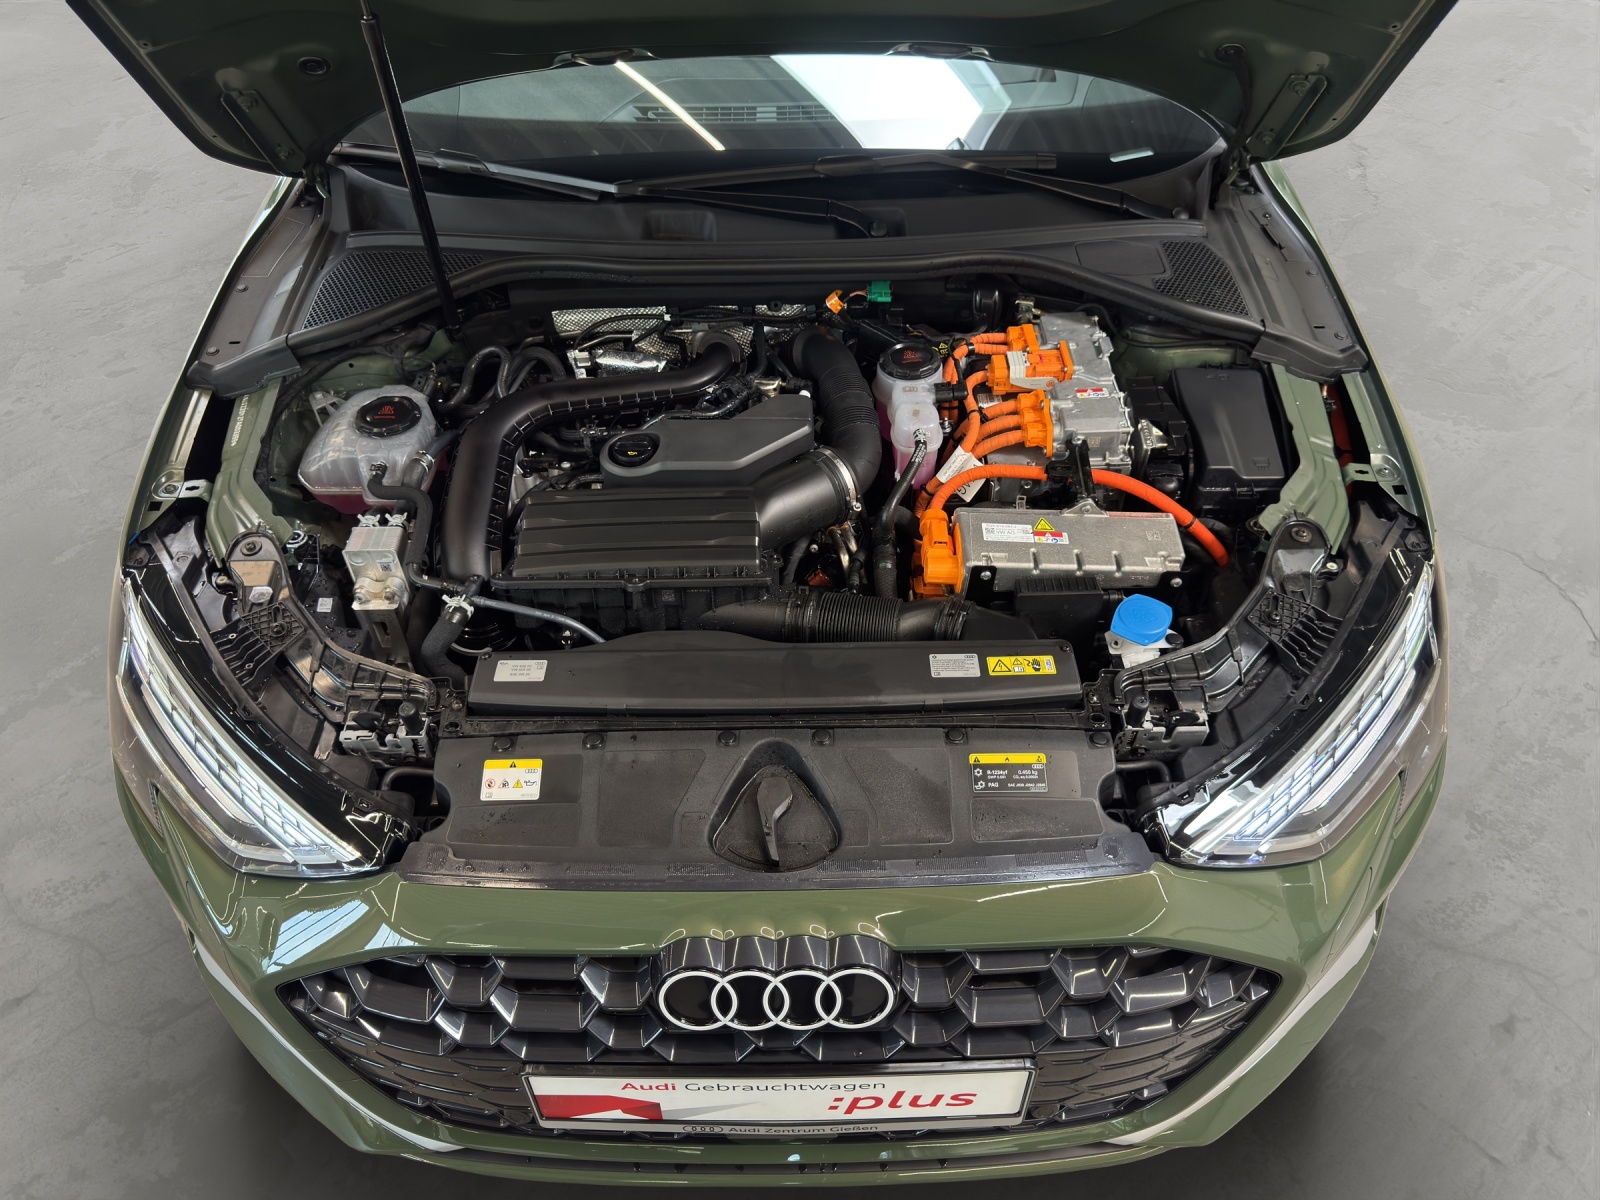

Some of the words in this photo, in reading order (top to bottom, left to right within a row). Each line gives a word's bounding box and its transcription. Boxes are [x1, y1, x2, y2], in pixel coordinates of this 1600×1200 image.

[621, 1082, 676, 1091] Audi
[684, 1082, 886, 1092] Gebrauchtwagen
[828, 1090, 978, 1114] :plus
